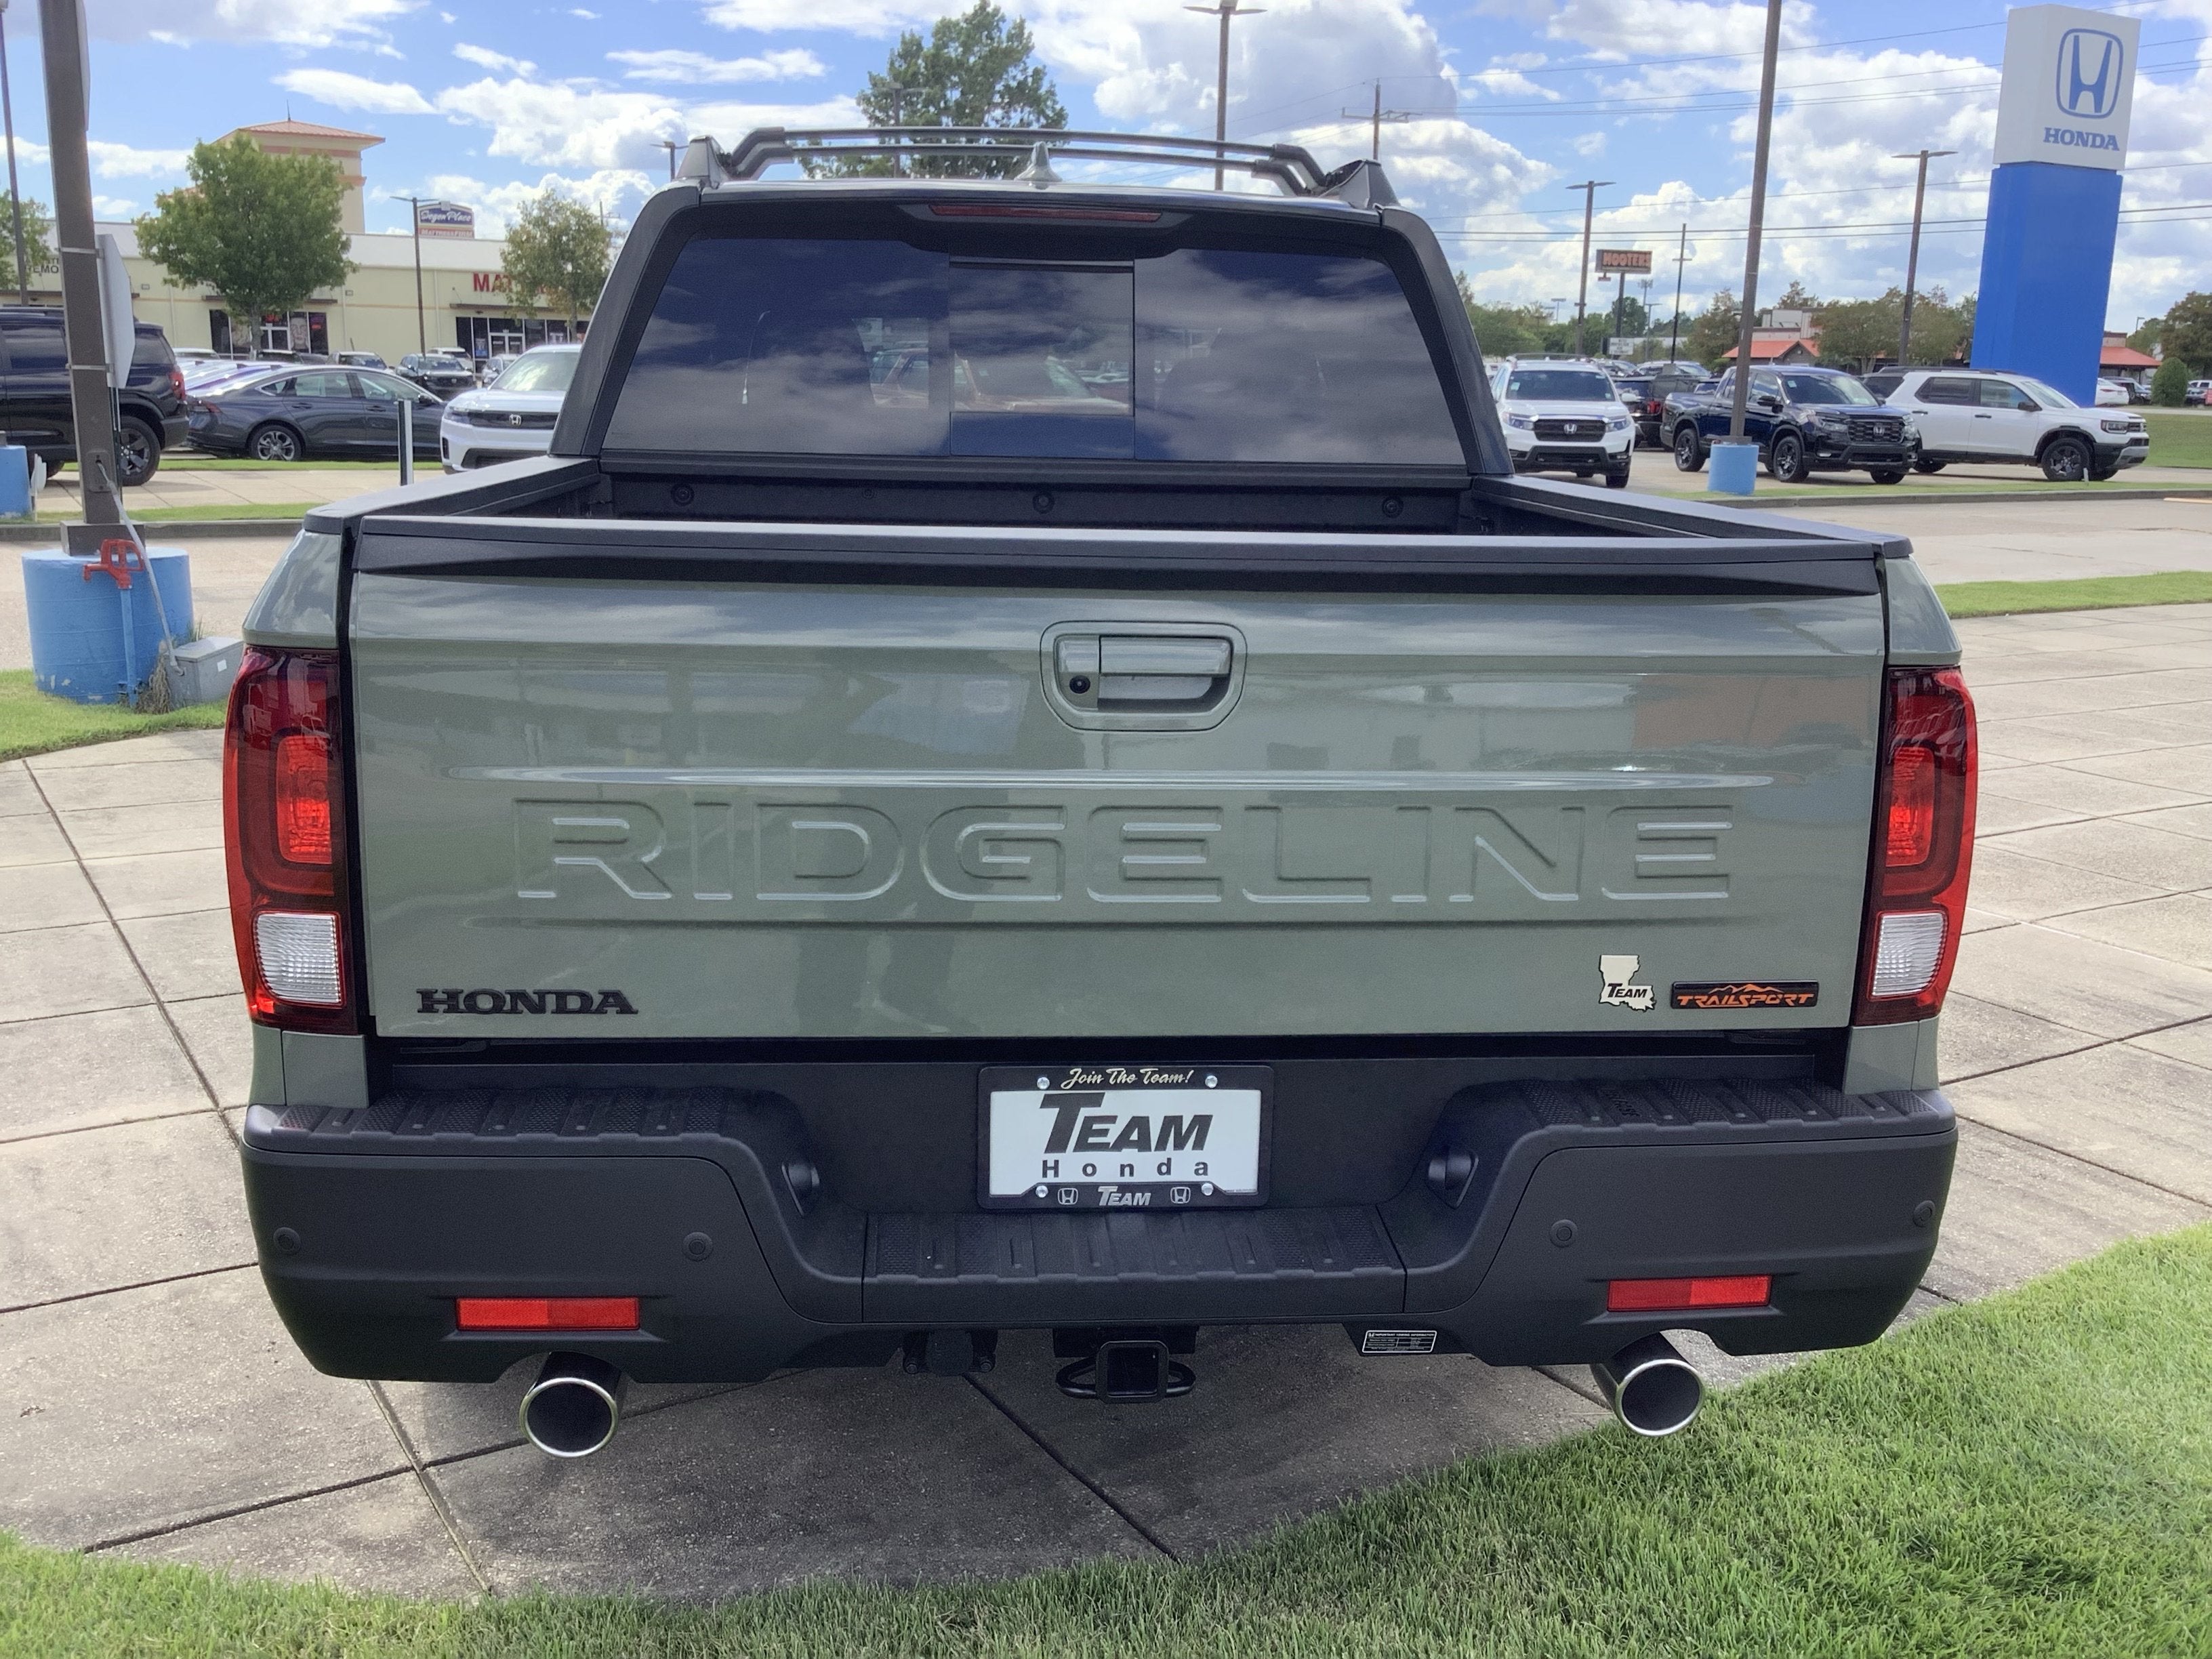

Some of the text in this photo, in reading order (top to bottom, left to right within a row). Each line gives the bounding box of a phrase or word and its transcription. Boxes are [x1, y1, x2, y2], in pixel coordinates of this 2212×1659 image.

[2043, 127, 2121, 152] HONDA
[1602, 252, 1650, 267] HOOTERS
[513, 798, 1734, 902] RIDGELINE
[415, 987, 639, 1015] HONDA
[1606, 983, 1648, 999] TEAM
[1677, 993, 1814, 1008] TRAILSPORT
[1060, 1067, 1195, 1090] Join The Team!
[1039, 1092, 1214, 1154] TEAM
[1041, 1157, 1209, 1179] Honda
[1097, 1185, 1151, 1206] TEAM
